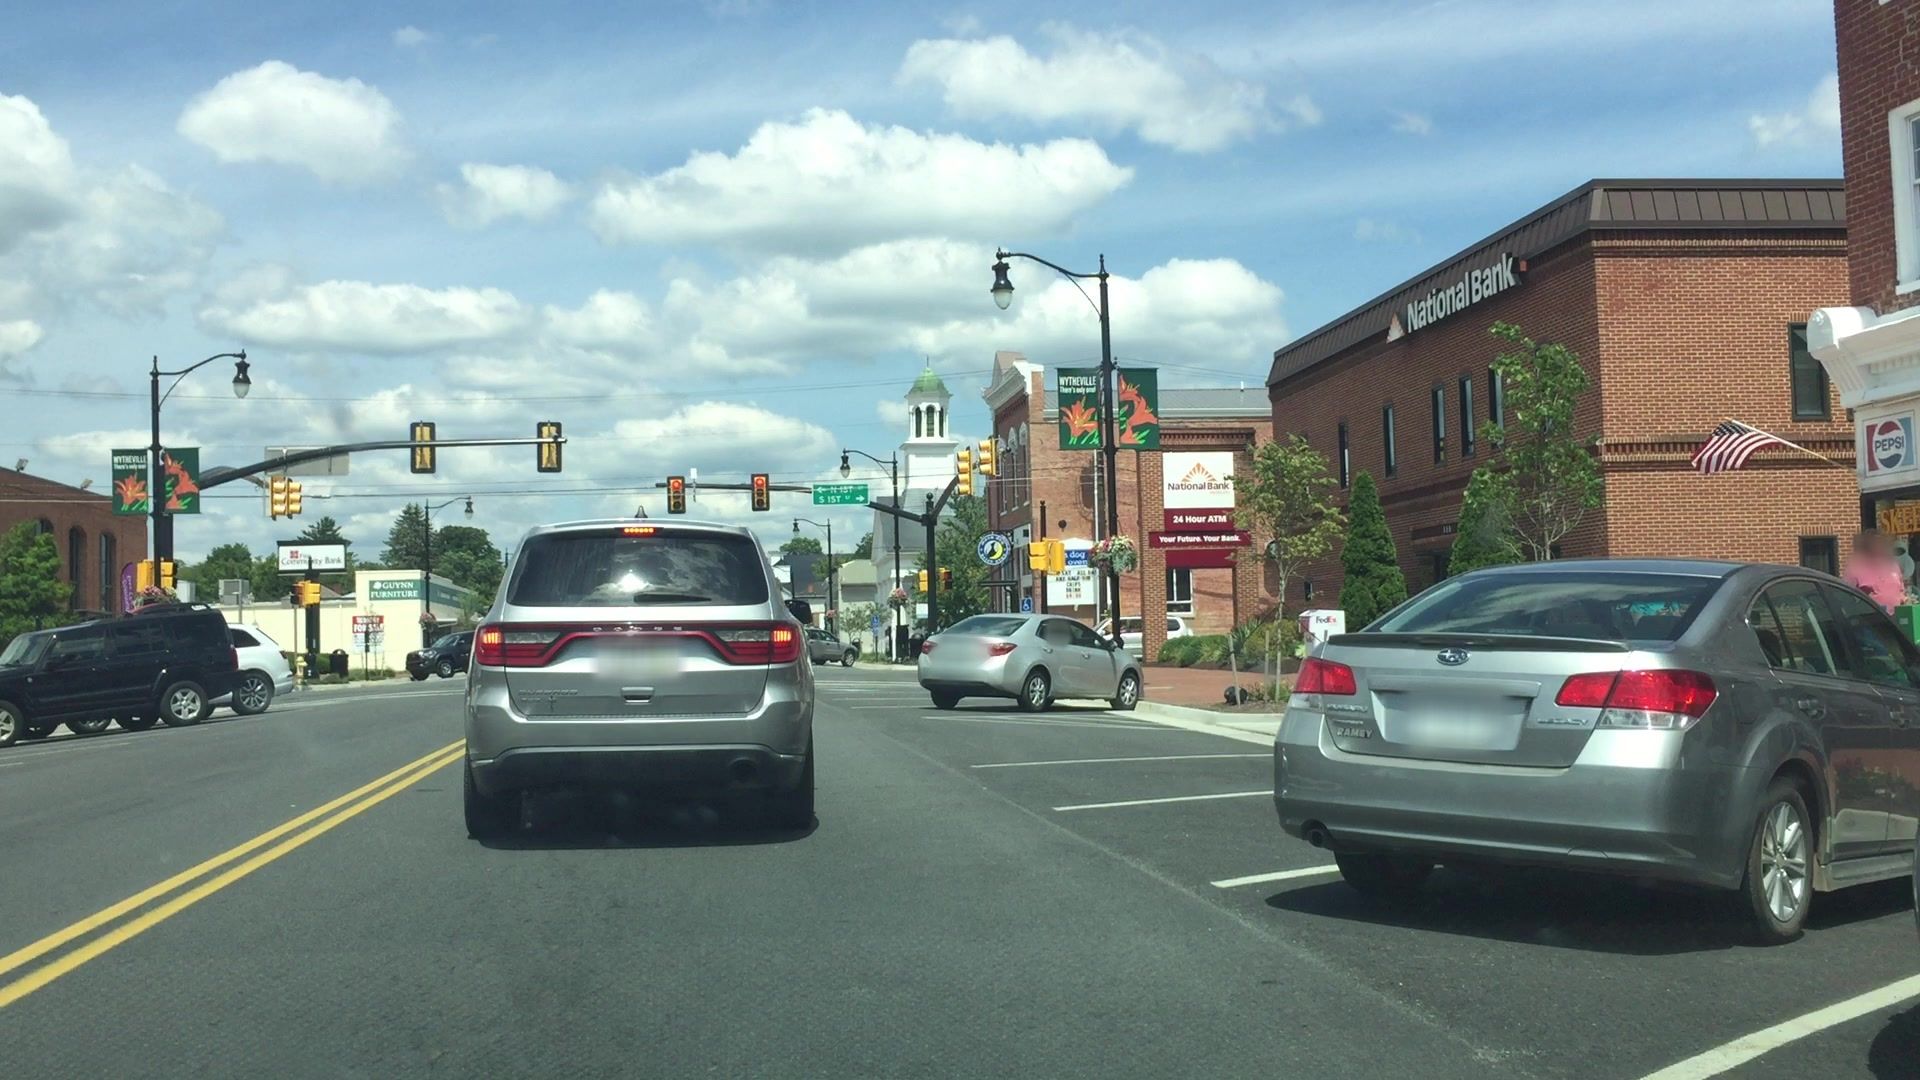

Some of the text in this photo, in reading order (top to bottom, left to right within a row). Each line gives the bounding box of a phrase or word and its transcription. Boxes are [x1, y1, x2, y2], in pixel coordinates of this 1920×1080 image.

[1407, 252, 1516, 333] National Bank
[1059, 376, 1097, 386] WYTHEVILLE
[1875, 436, 1904, 453] PEPSI
[113, 455, 147, 464] WYTHEVILLE
[1168, 482, 1230, 490] National Bank
[1173, 515, 1227, 523] 24 Hour ATM
[1069, 550, 1086, 559] dog
[325, 556, 342, 564] Bank
[382, 582, 414, 590] GUYNN
[370, 590, 418, 598] FURNITURE
[1316, 616, 1336, 624] FedEx
[354, 624, 366, 633] FOR
